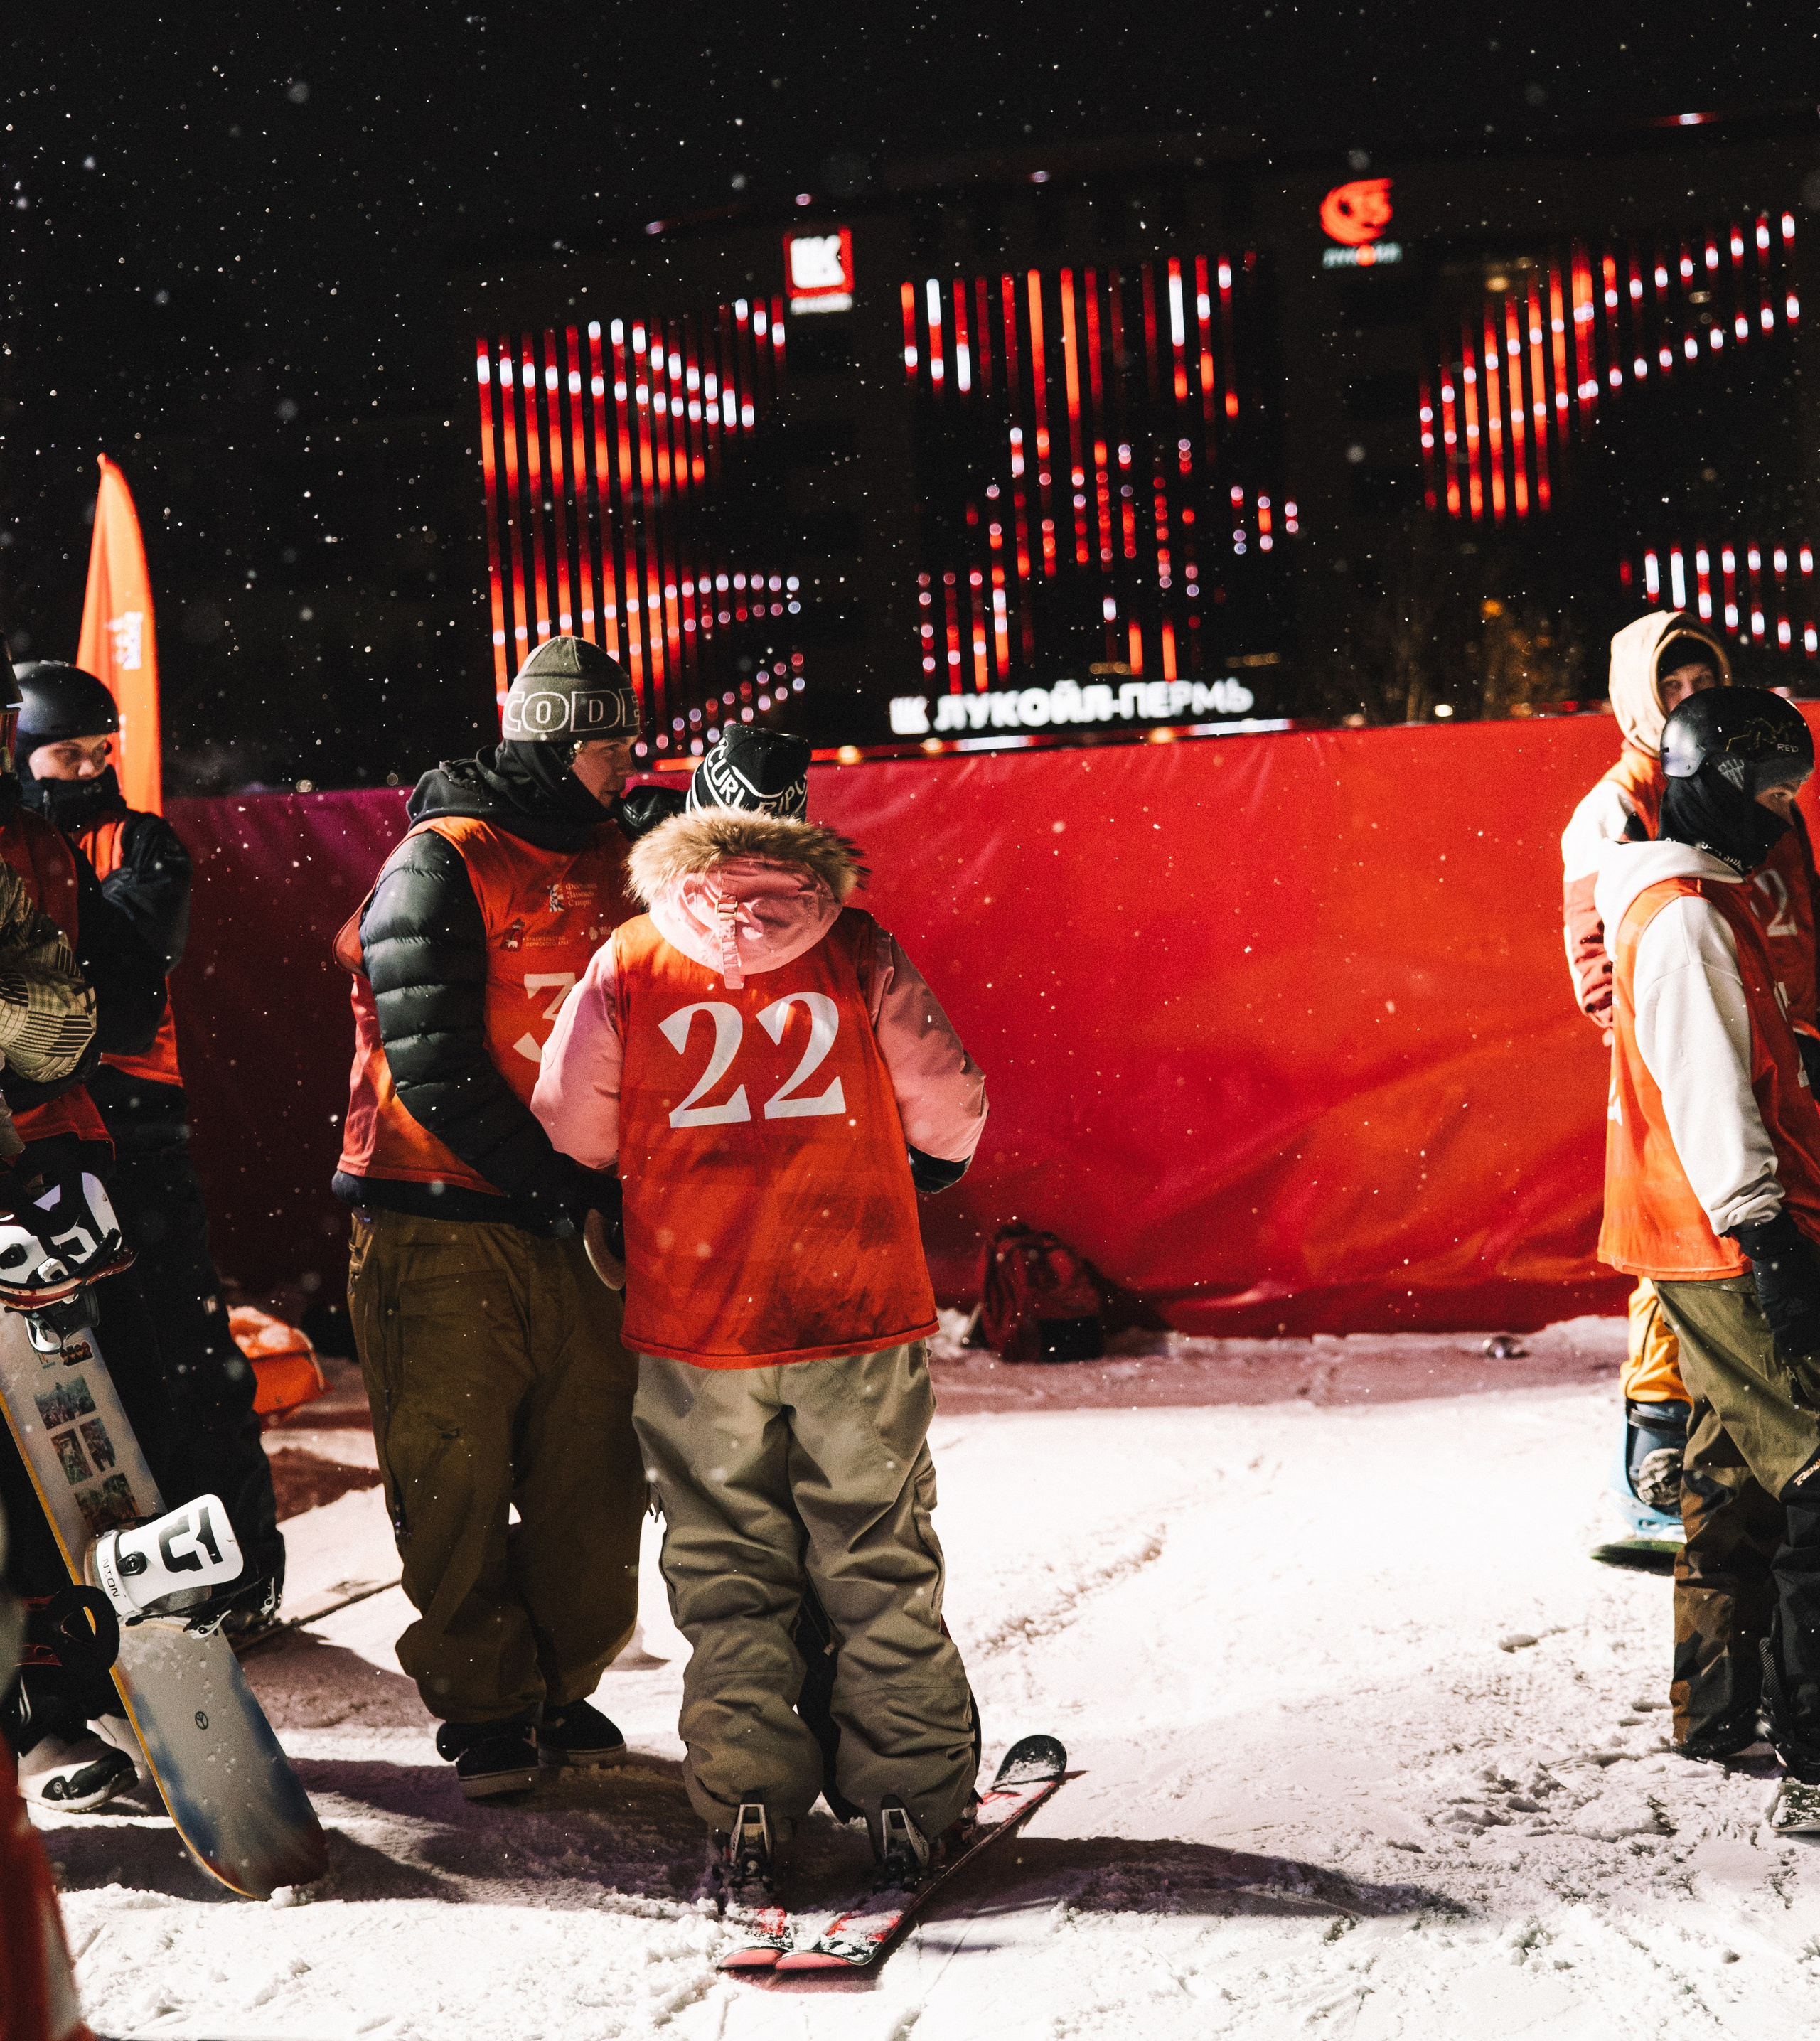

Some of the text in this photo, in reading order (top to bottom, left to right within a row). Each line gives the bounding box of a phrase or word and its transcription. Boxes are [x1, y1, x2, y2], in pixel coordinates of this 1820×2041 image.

[503, 687, 640, 732] CODE
[933, 677, 1254, 732] ЛУКОЙЛ-ПЕРМЬ
[1777, 744, 1799, 753] RED
[708, 745, 746, 813] CURL
[1750, 869, 1797, 937] 2
[658, 992, 846, 1128] 22
[102, 1553, 120, 1597] NION
